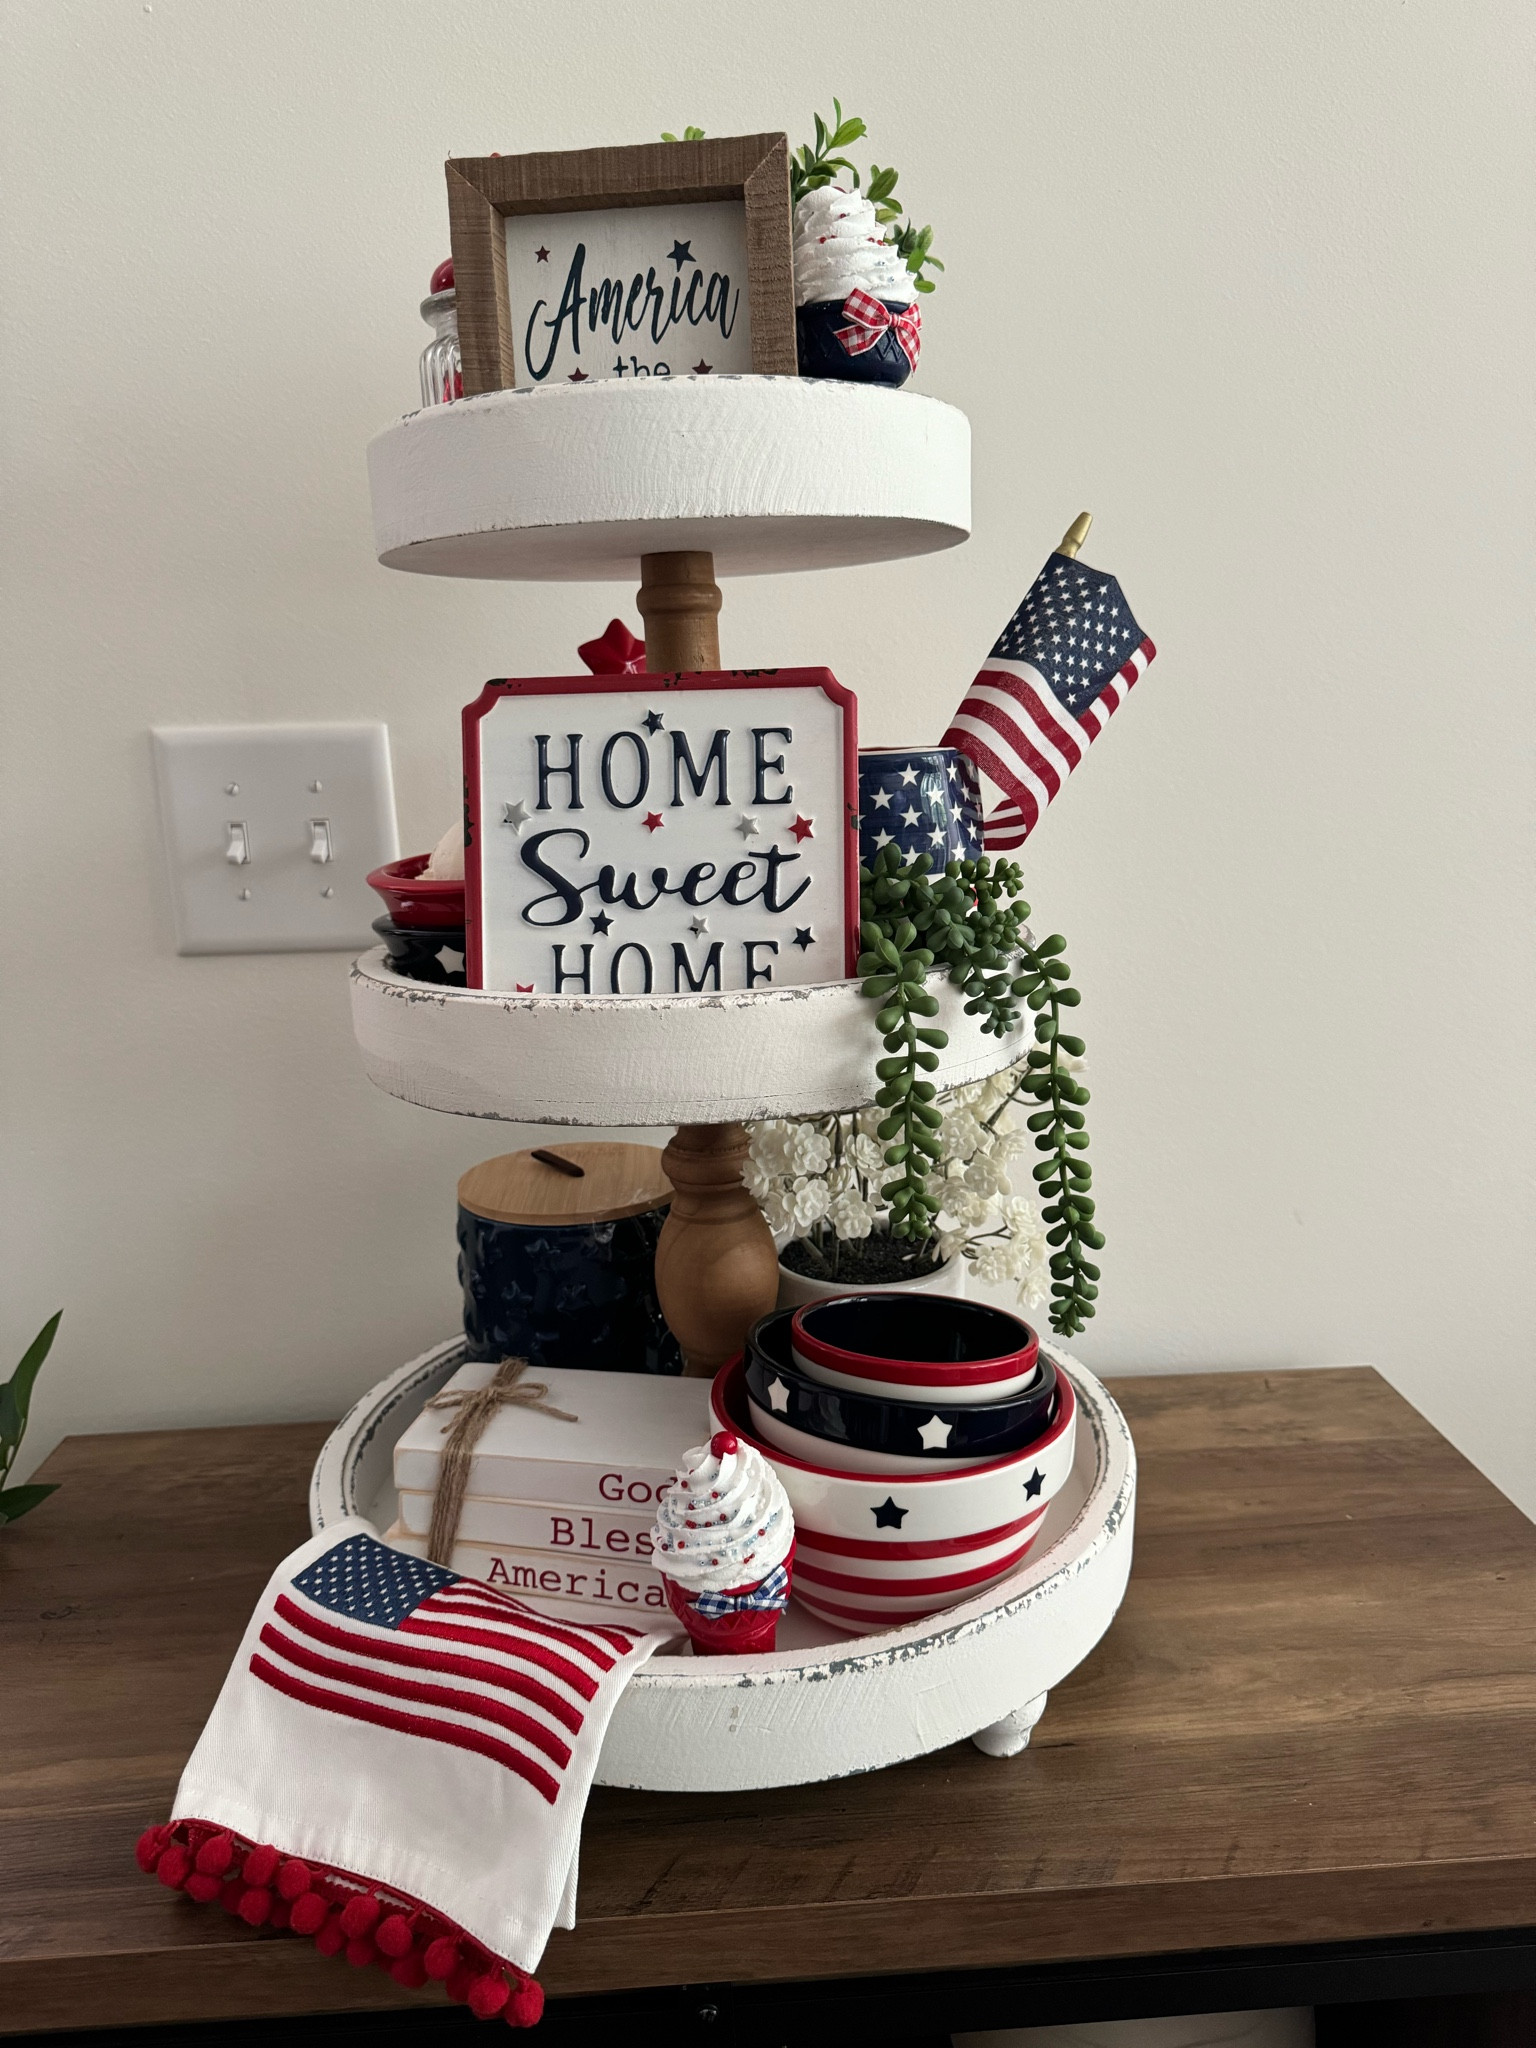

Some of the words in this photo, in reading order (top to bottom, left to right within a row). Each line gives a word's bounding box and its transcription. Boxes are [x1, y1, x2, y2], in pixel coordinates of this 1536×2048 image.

[525, 243, 739, 381] America
[612, 356, 671, 378] the
[534, 728, 793, 809] HOME
[520, 828, 812, 926] Sweet
[487, 1557, 667, 1608] America
